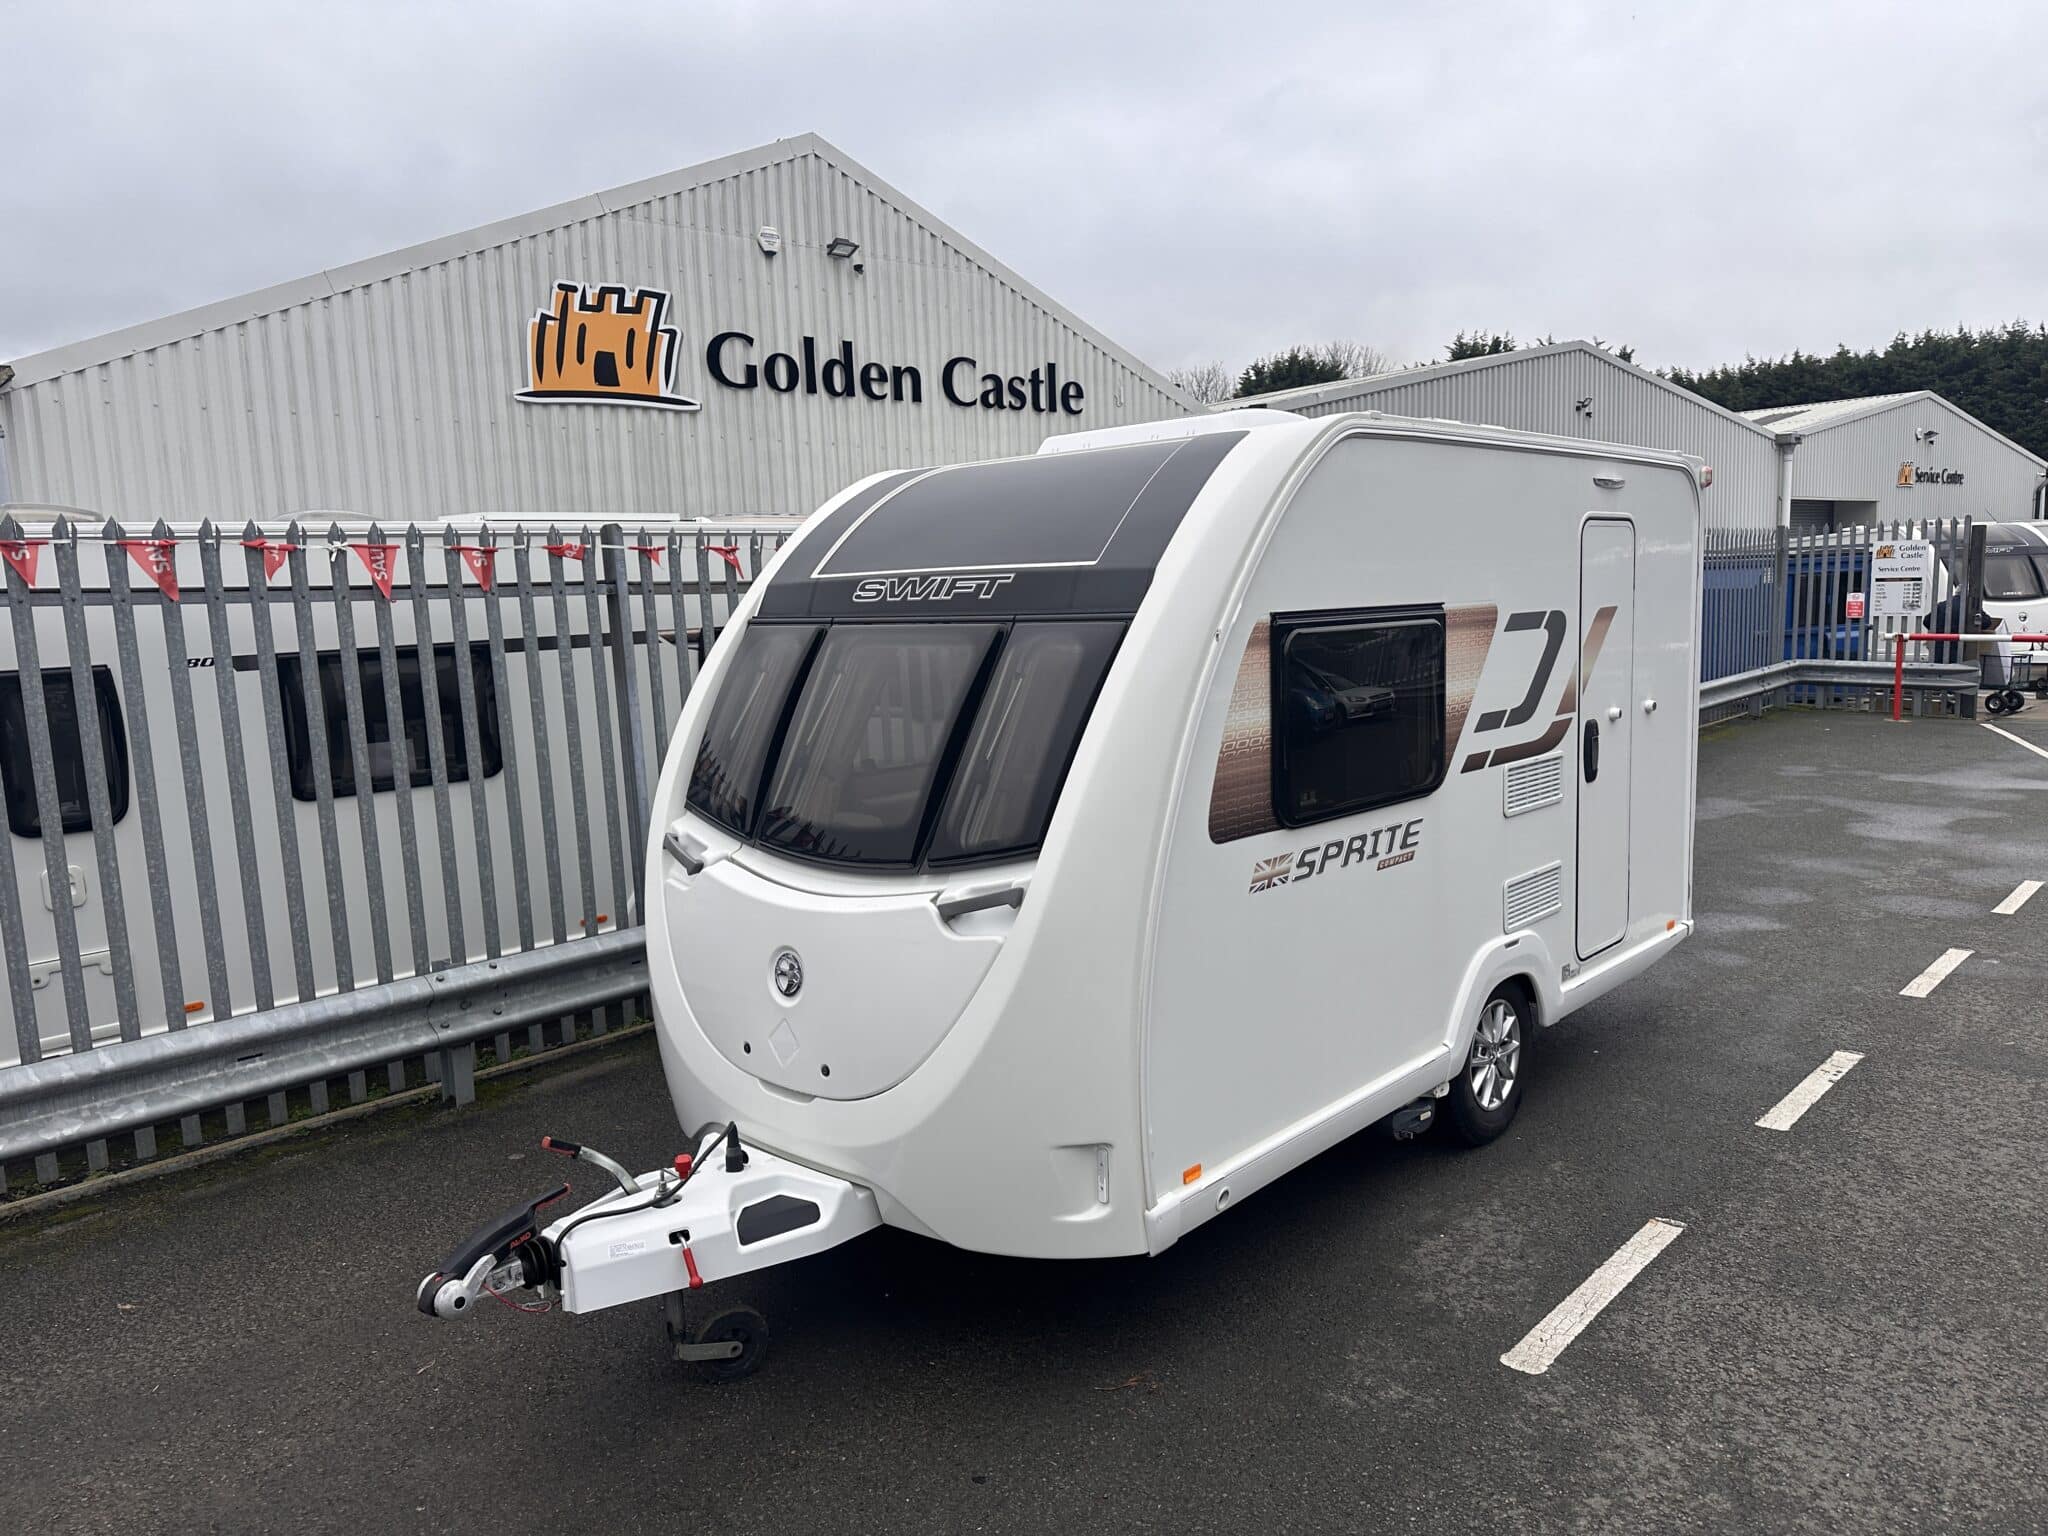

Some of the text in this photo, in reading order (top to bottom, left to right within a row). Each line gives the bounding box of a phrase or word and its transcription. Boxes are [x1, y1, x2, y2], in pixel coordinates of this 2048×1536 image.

[706, 331, 1085, 415] Golden Castle
[1915, 466, 1965, 485] Service Centre
[1898, 544, 1927, 552] Golden
[1900, 551, 1924, 559] Castle
[852, 573, 1016, 602] SWIFT
[1291, 818, 1424, 882] SPRITE
